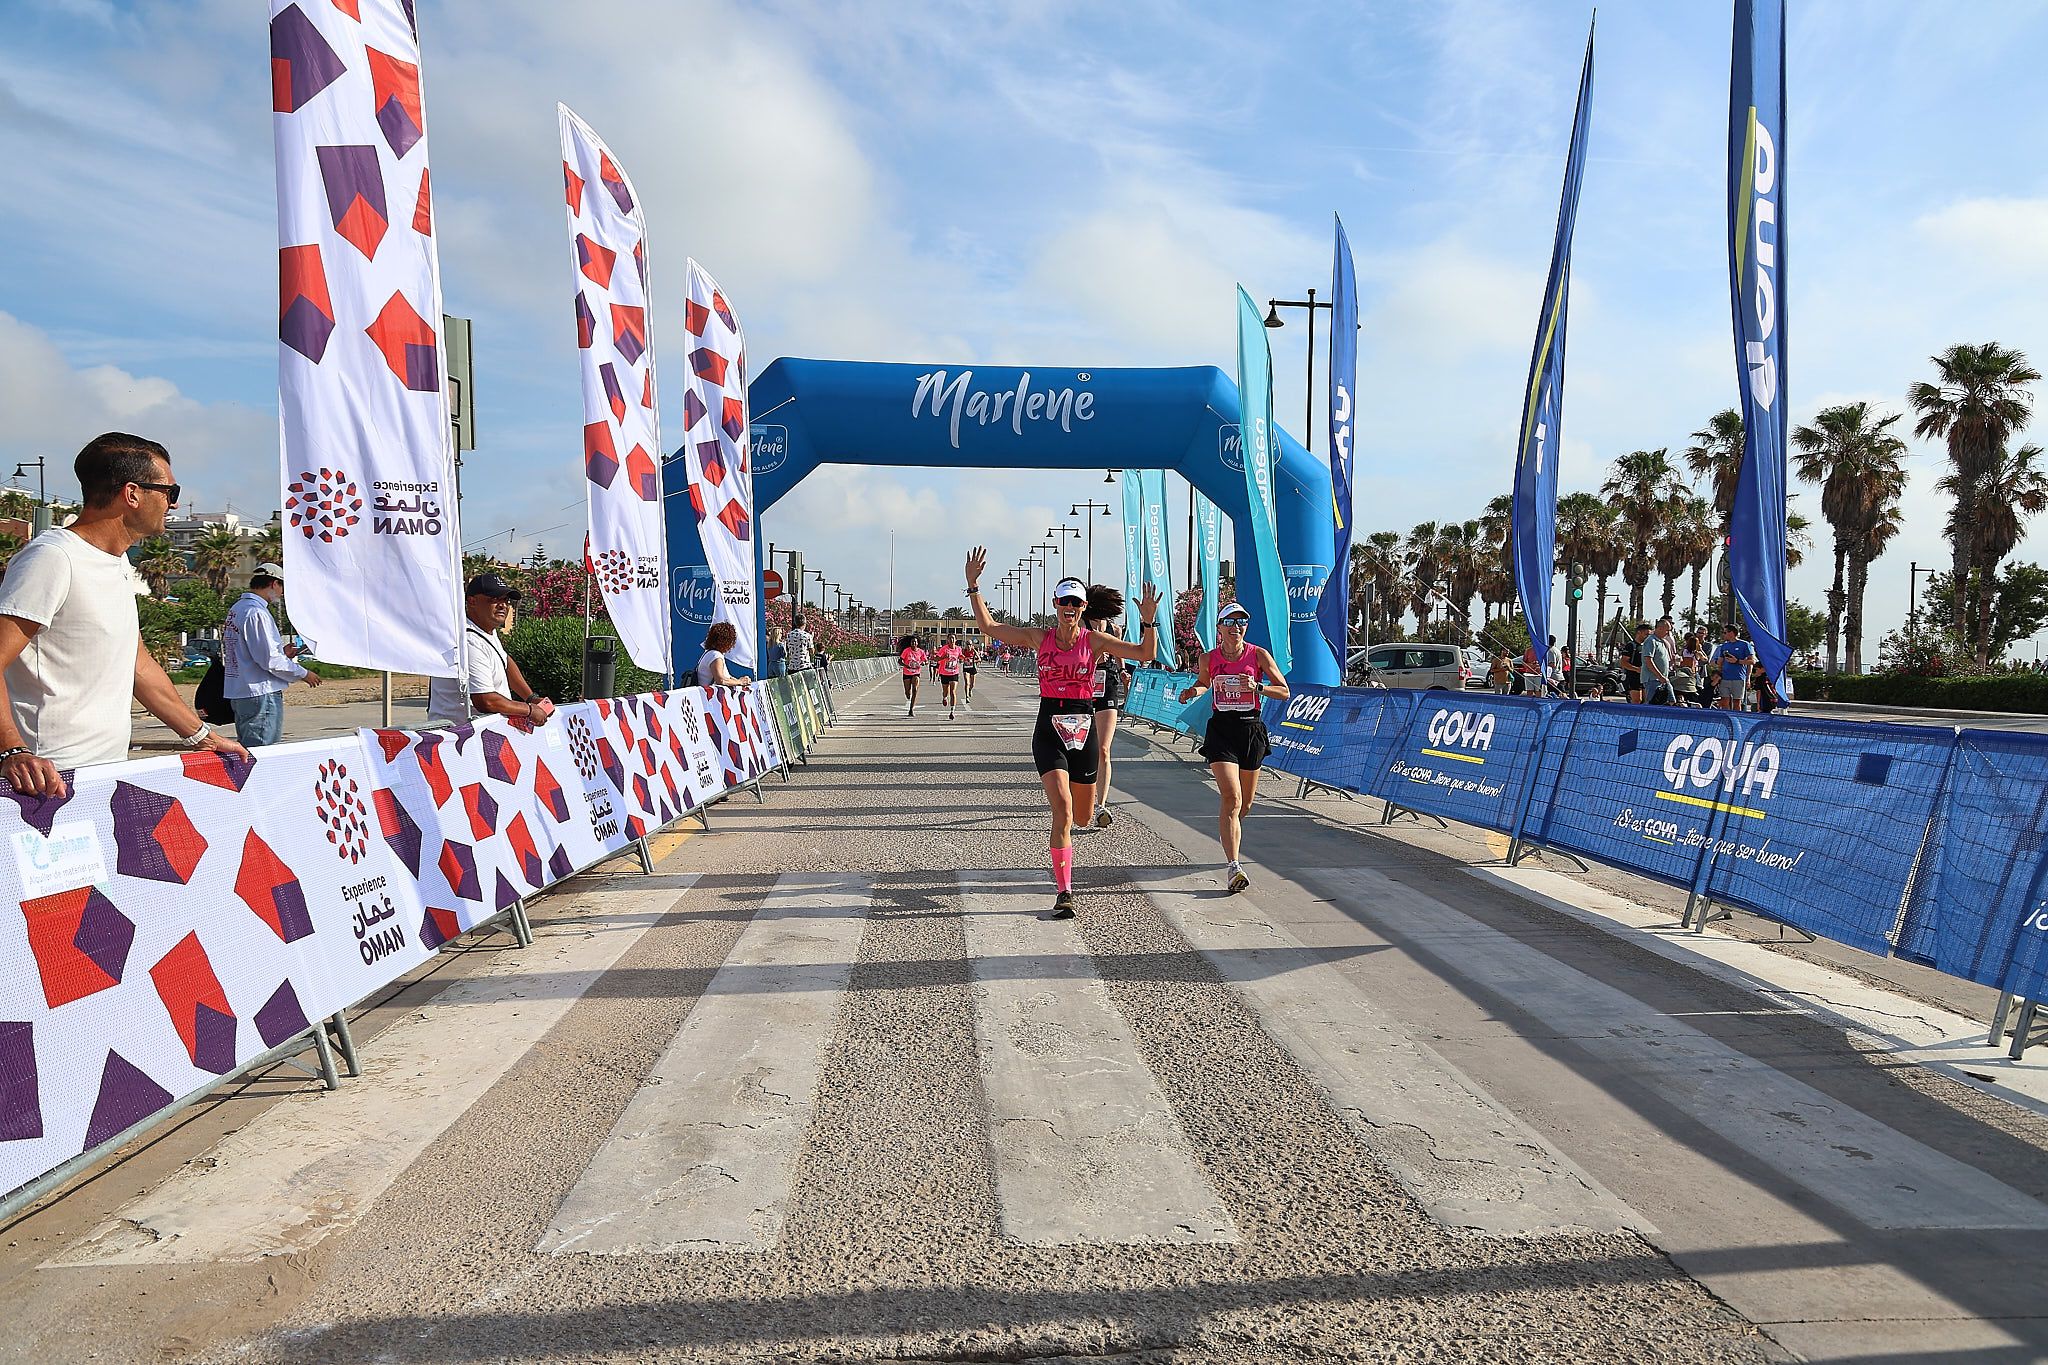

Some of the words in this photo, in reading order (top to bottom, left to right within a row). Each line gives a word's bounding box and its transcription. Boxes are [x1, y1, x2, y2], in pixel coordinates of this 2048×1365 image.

[1286, 694, 1331, 722] GOYA
[1428, 708, 1496, 750] GOYA
[1402, 768, 1411, 776] es
[1410, 766, 1432, 781] GOYA
[1448, 778, 1464, 796] que
[1464, 781, 1478, 792] ser
[1477, 776, 1504, 798] bueno!
[1664, 734, 1780, 800] GOYA
[582, 788, 608, 804] Experience
[594, 818, 619, 842] OMAN
[1632, 820, 1644, 832] es
[1644, 818, 1678, 840] GOYA
[1711, 838, 1736, 865] que
[1735, 842, 1756, 858] ser
[1756, 838, 1804, 872] bueno!
[340, 875, 387, 902] Experience
[359, 924, 406, 966] OMAN
